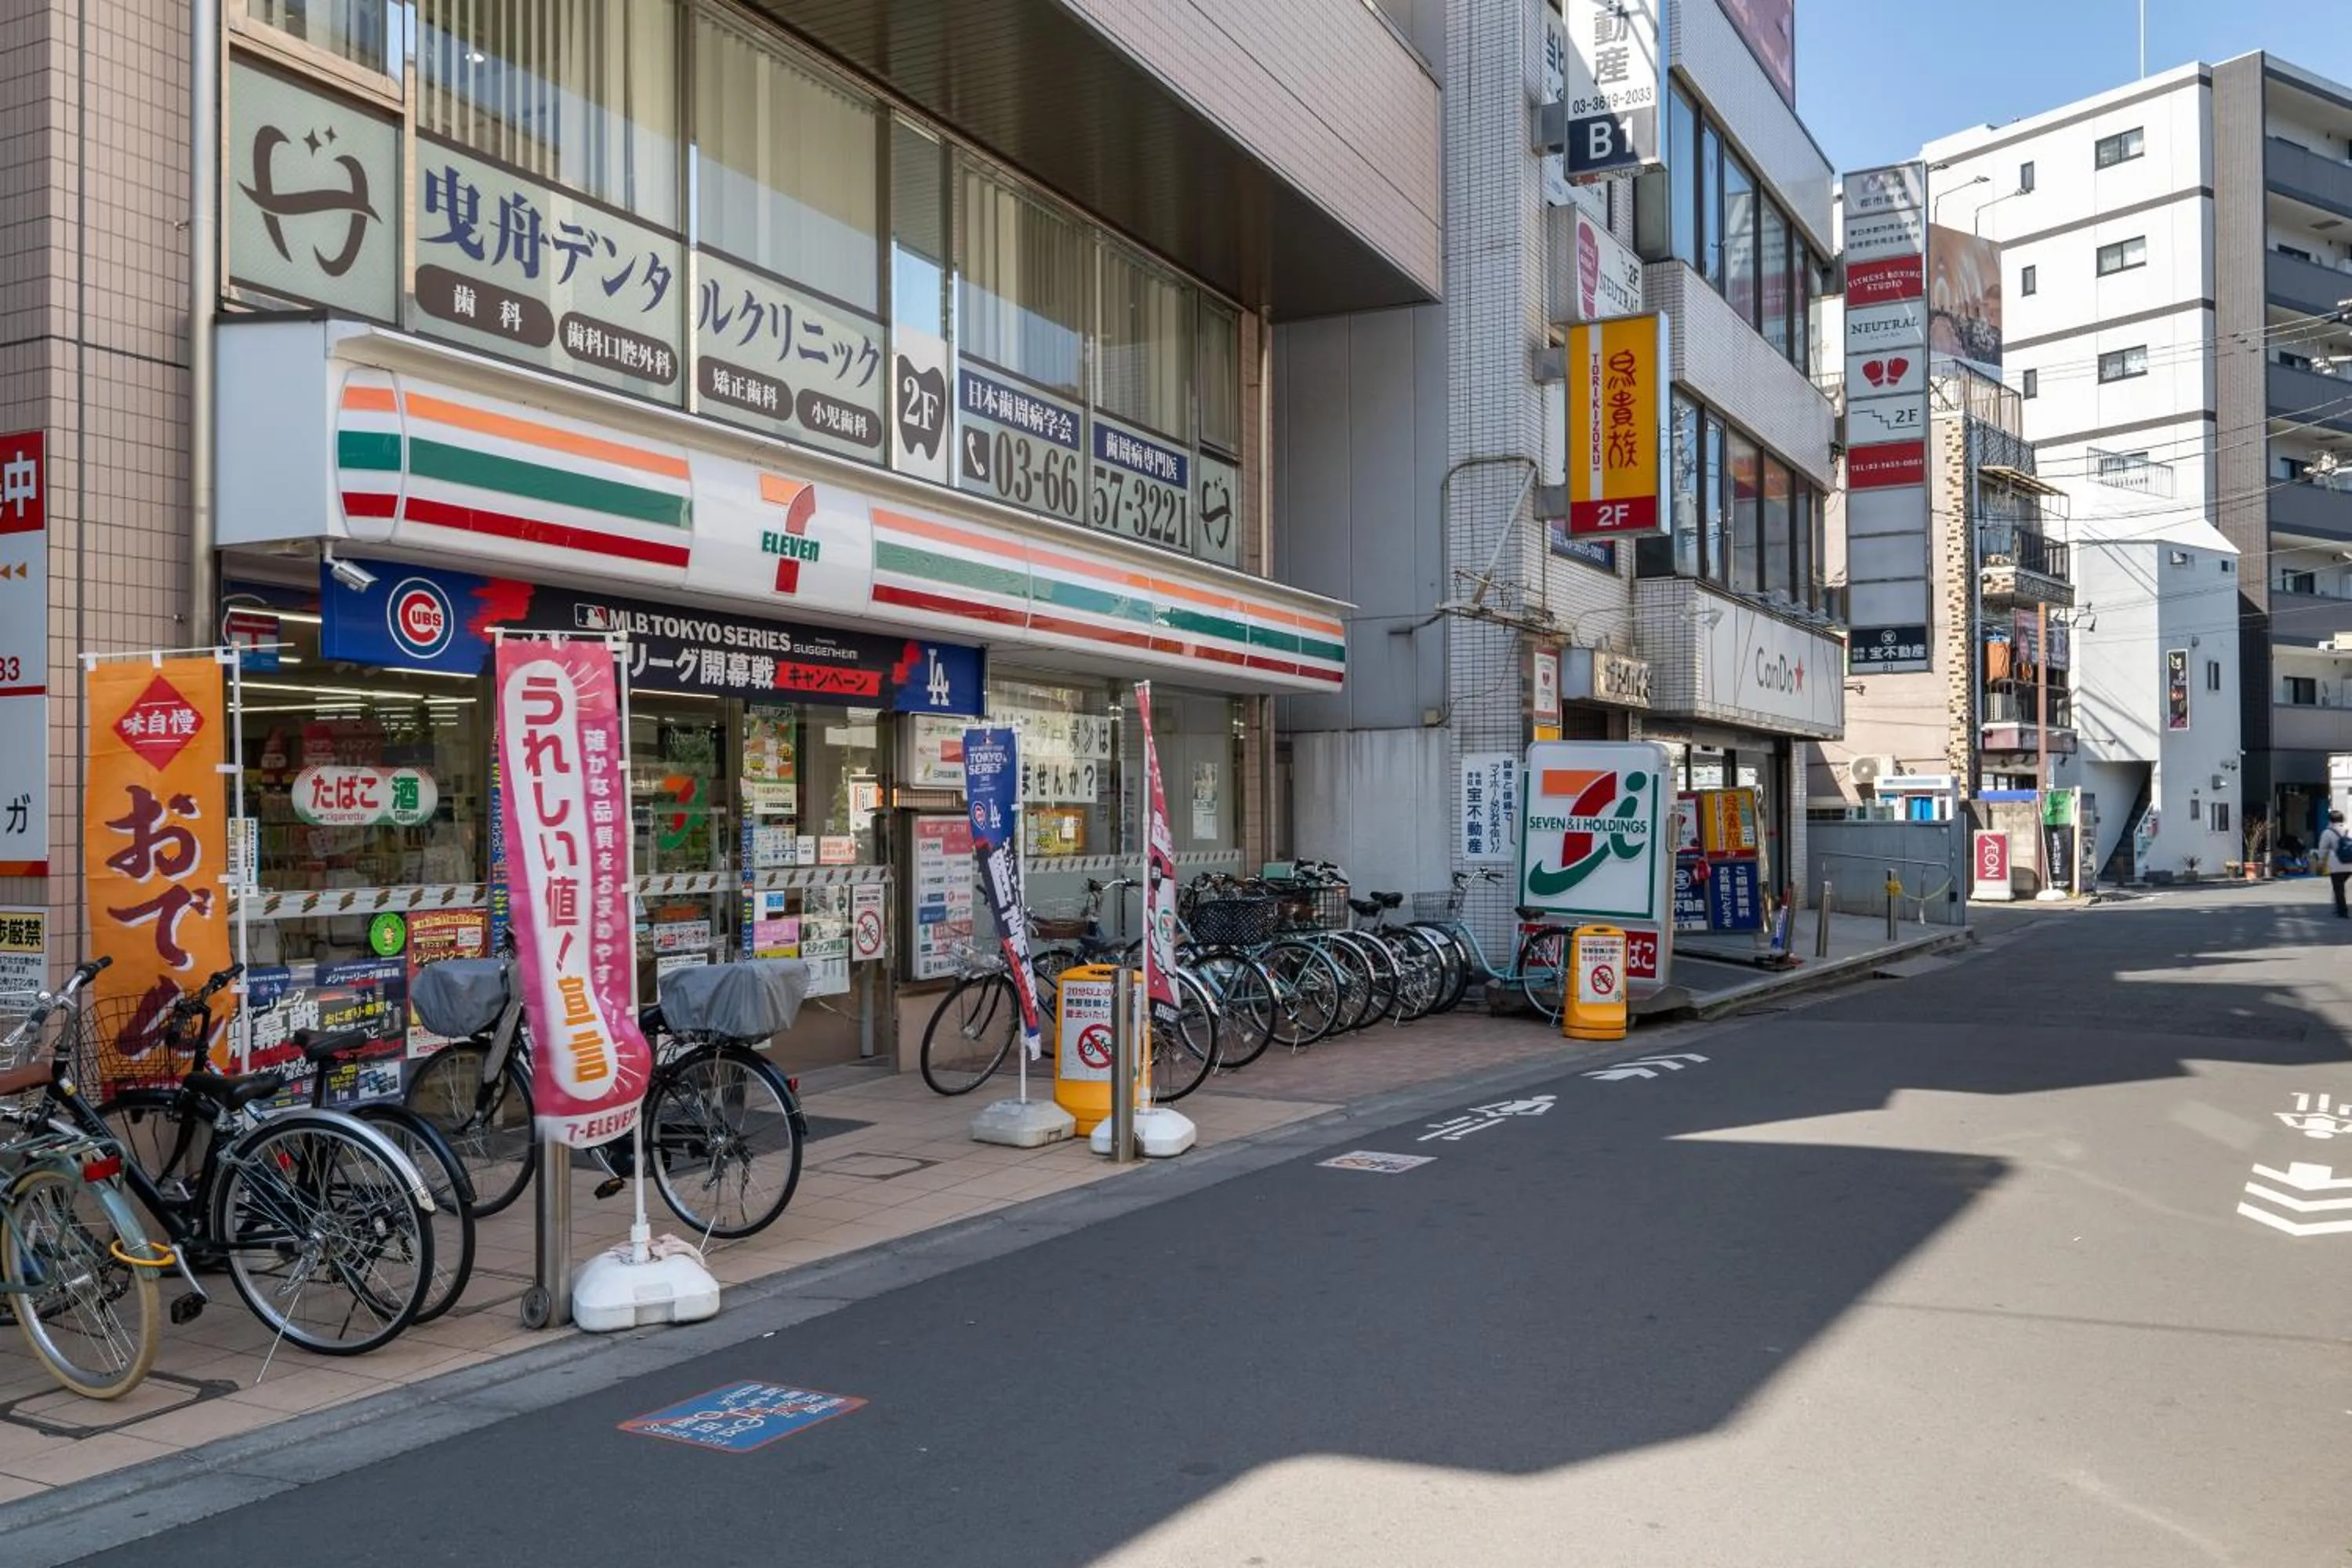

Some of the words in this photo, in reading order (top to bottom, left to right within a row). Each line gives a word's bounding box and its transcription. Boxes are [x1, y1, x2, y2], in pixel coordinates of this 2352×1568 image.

[1572, 87, 1652, 114] 03-3619-2033
[1589, 116, 1633, 160] B1
[1850, 316, 1919, 335] NEUTRAL
[566, 321, 672, 379] 歯科口腔外科
[712, 367, 779, 411] 矯正歯科
[902, 376, 938, 431] 2F
[811, 400, 868, 438] 小児歯科
[967, 379, 1073, 443] 日本歯周病学会
[1895, 408, 1918, 423] 2F
[1105, 431, 1178, 481] 歯周病専門医
[1596, 504, 1630, 527] 2F
[650, 615, 722, 643] TOKYO
[723, 626, 791, 652] SERIES
[1869, 643, 1926, 659] 宝不動産
[787, 666, 869, 691] キャンペーン
[1755, 648, 1794, 694] CanDo
[122, 708, 197, 735] 味自慢
[312, 775, 379, 810] たばこ
[392, 777, 419, 810] 酒
[1467, 787, 1483, 854] 宝不動産
[1583, 818, 1647, 833] HOLDINGS
[1627, 939, 1655, 970] ばこ
